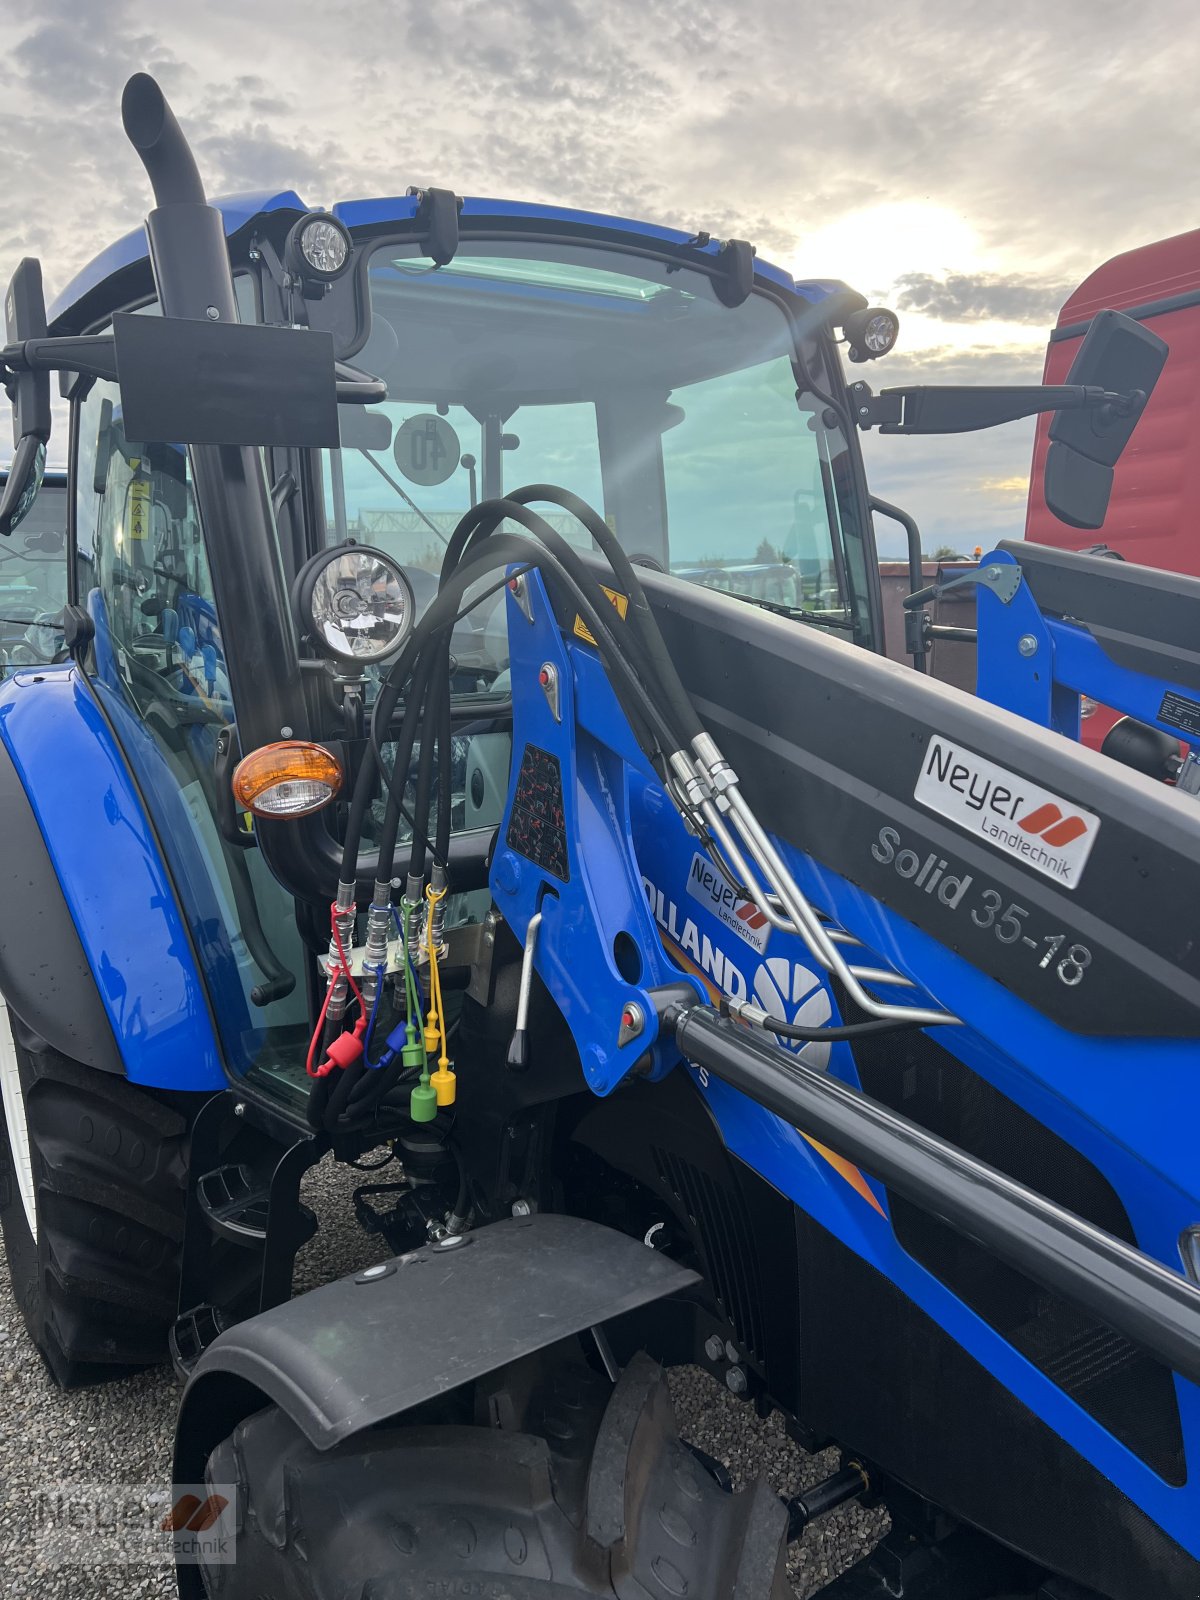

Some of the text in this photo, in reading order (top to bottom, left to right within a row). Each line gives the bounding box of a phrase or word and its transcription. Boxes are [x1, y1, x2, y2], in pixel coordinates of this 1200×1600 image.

[926, 743, 1024, 820] Neyer
[981, 816, 1072, 879] Landtechnik
[691, 857, 739, 911] Neyer
[871, 826, 1093, 985] Solid 35-18
[718, 906, 763, 950] Landtechnik
